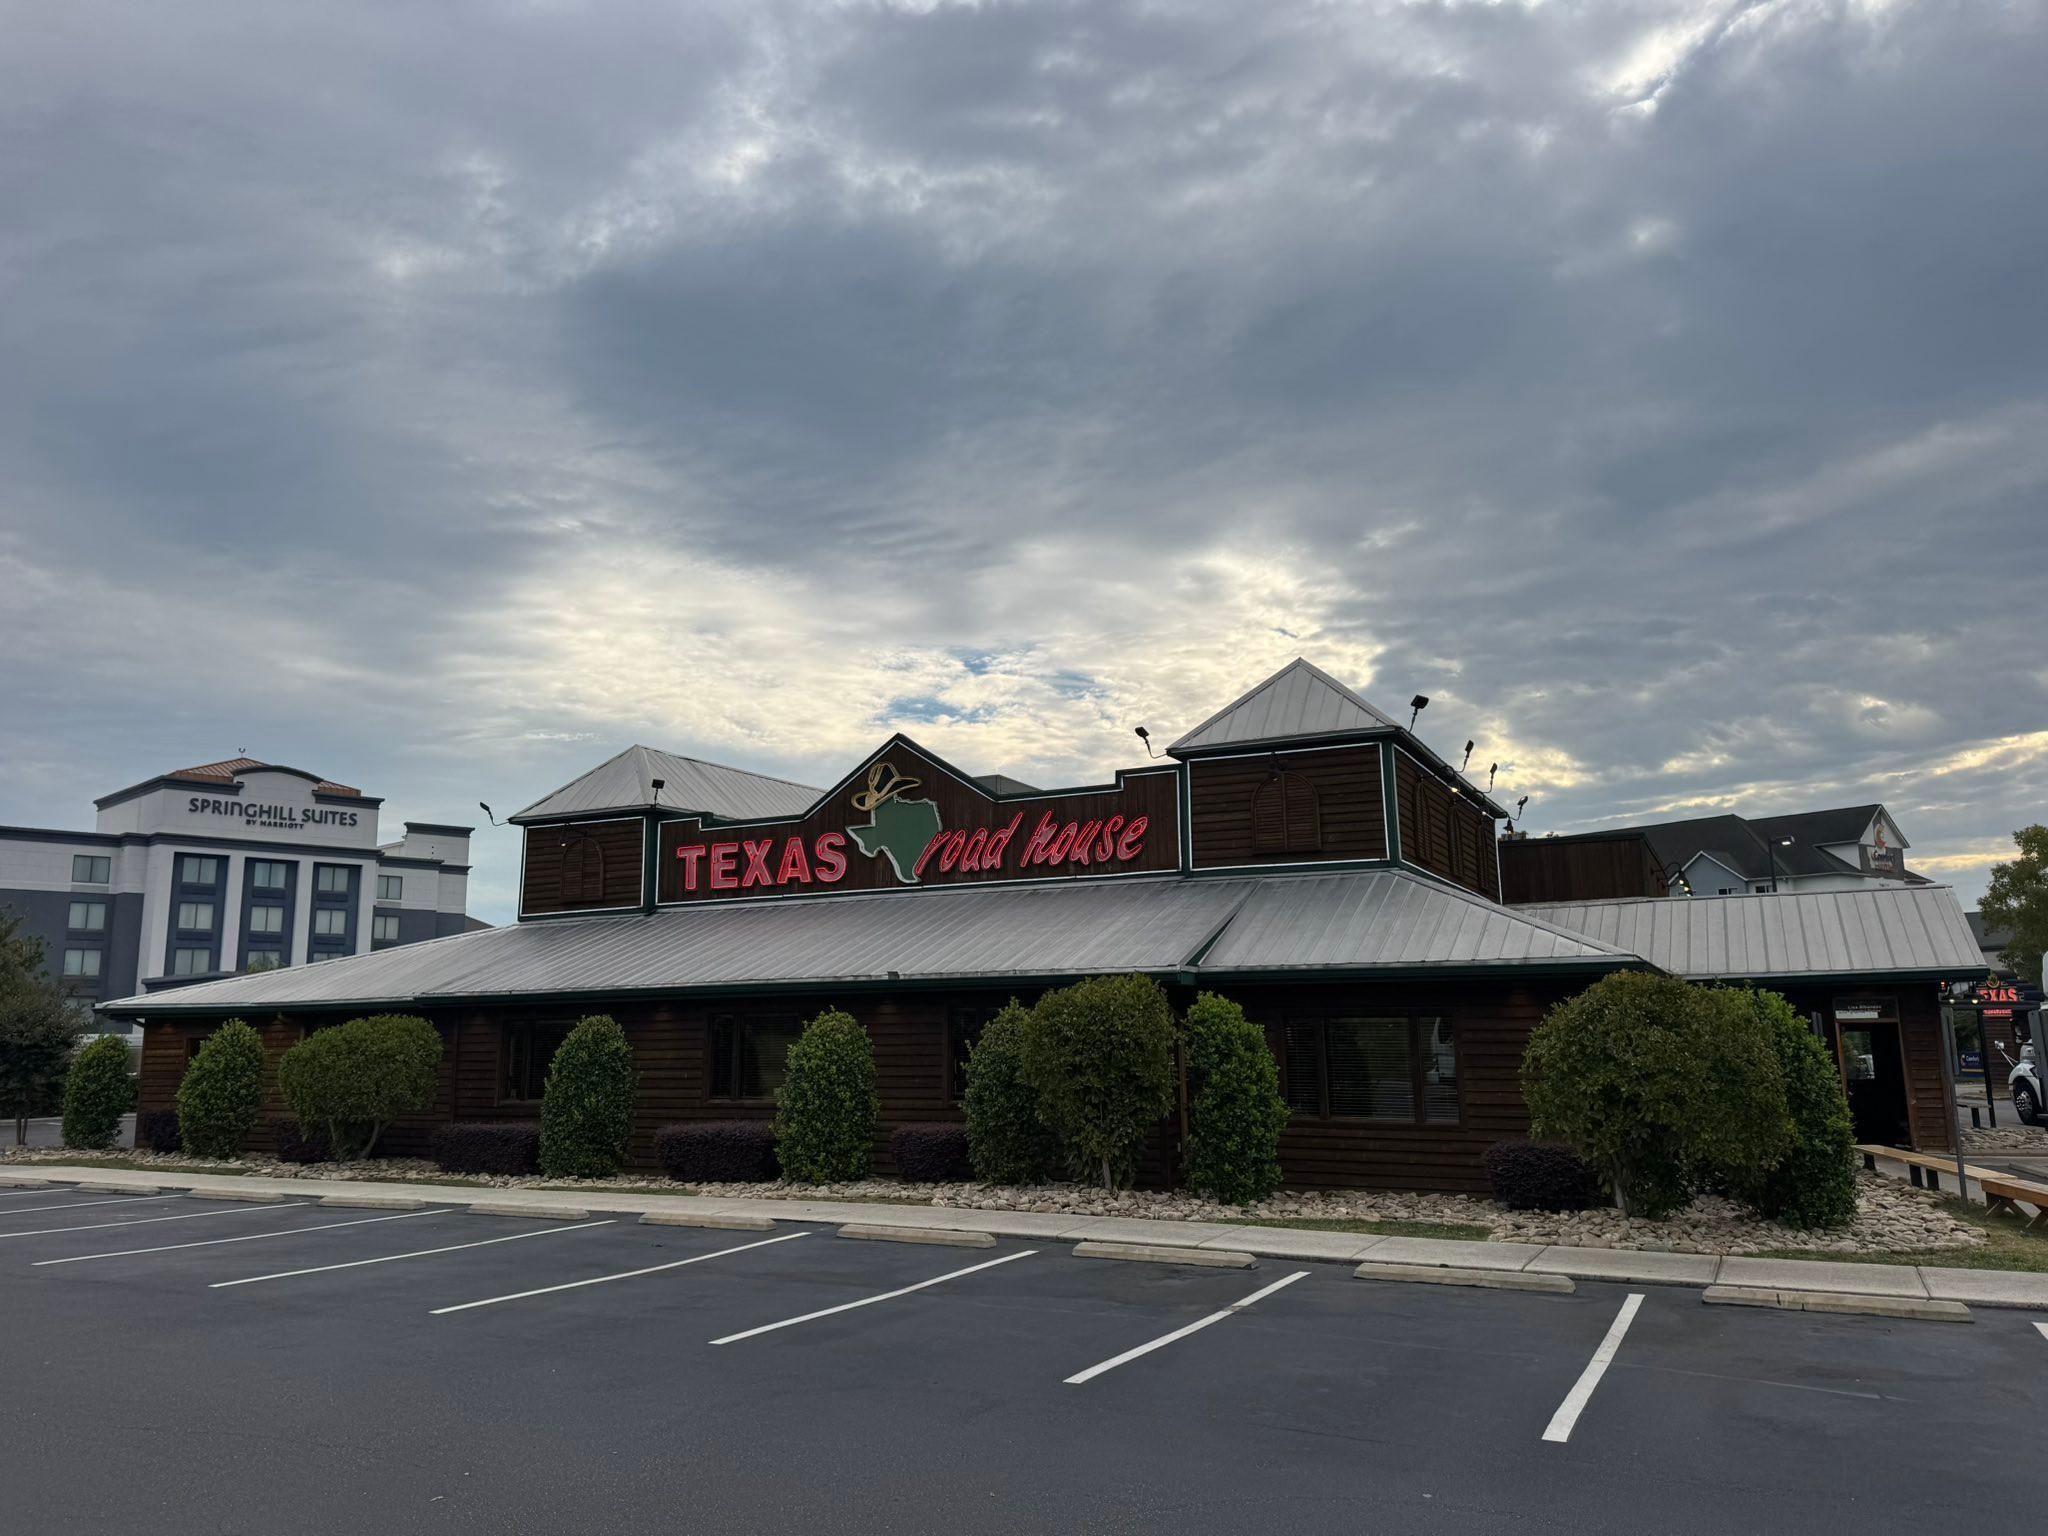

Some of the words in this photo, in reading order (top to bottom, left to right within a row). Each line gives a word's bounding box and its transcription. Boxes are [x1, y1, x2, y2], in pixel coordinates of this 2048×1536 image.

[188, 797, 296, 821] SPRINGHILL
[301, 808, 358, 827] SUITES
[260, 820, 304, 829] MARRIOTT
[676, 832, 847, 891] TEXAS
[914, 811, 1024, 877] road
[1020, 810, 1149, 868] house
